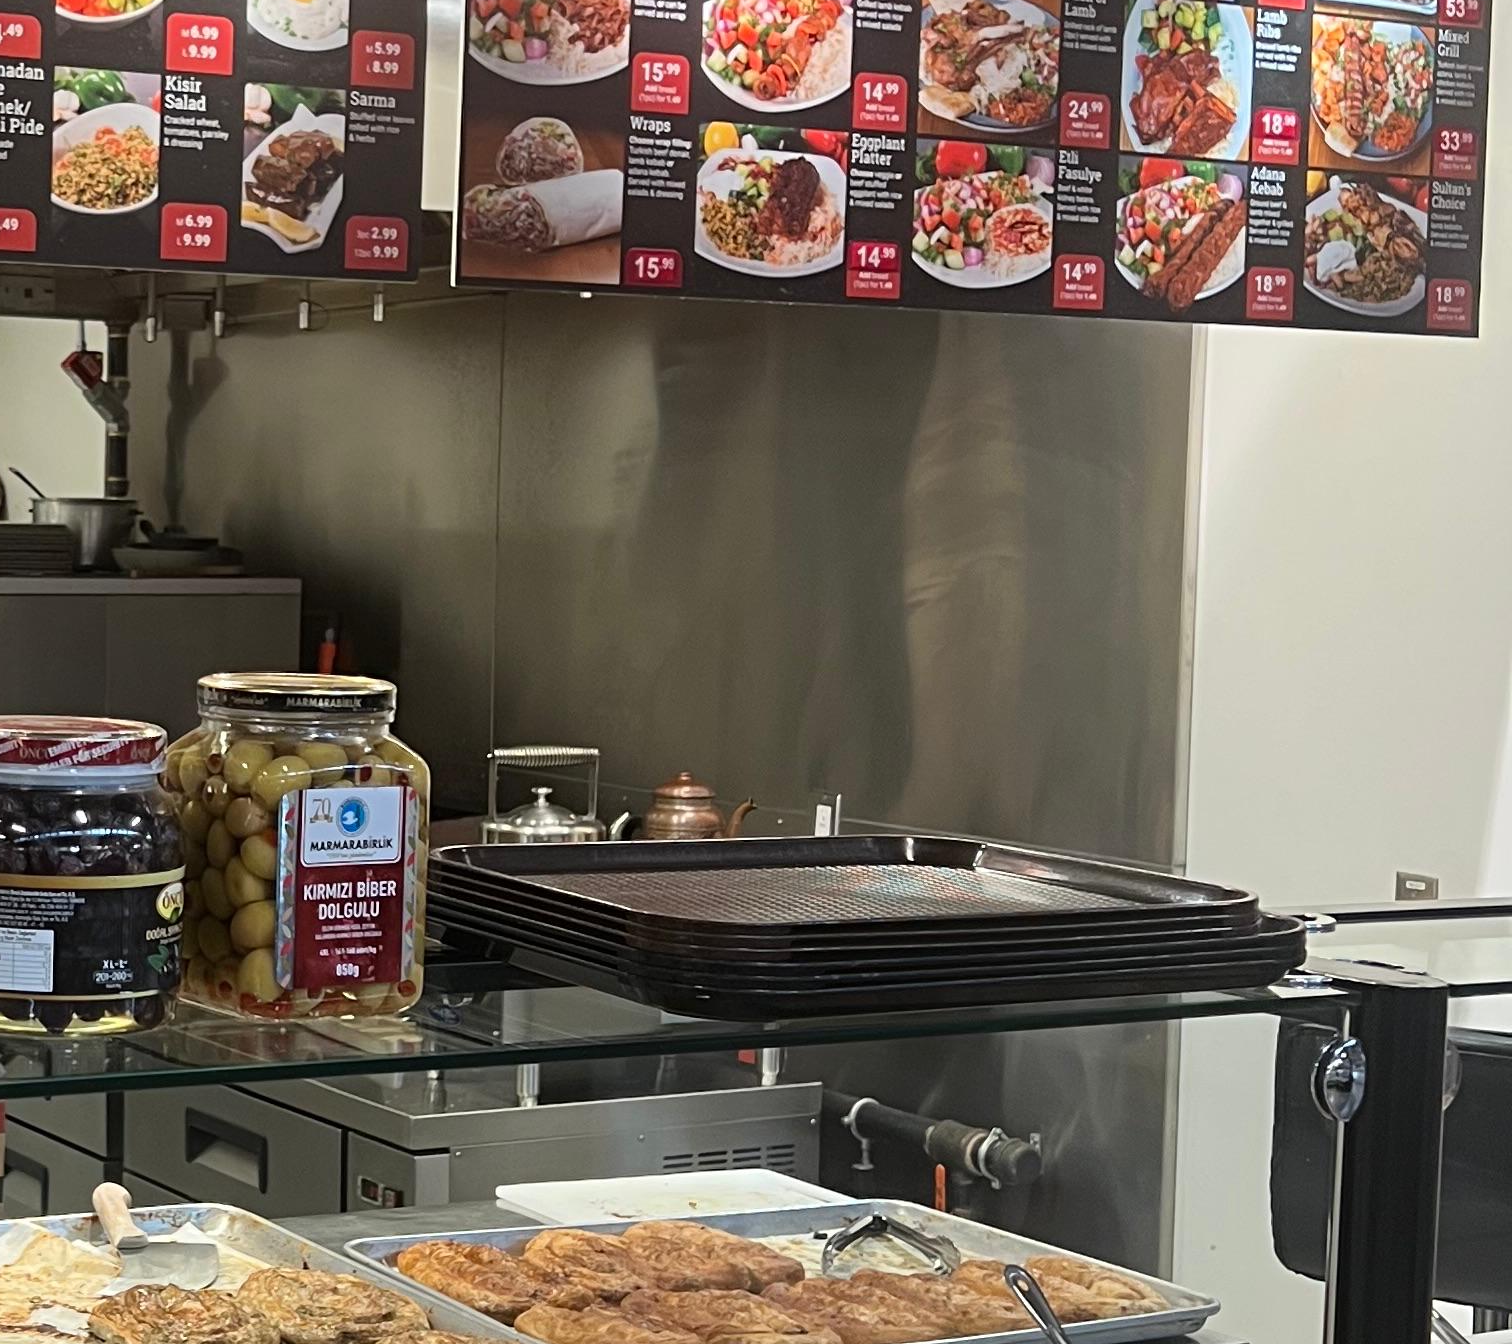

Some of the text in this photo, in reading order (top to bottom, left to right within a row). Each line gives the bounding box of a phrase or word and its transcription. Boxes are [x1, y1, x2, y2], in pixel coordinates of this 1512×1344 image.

[1065, 2, 1096, 18] Lamb
[1257, 9, 1288, 25] Lamb
[190, 25, 219, 40] 6.99
[1257, 24, 1281, 39] Ribs
[1439, 29, 1469, 44] Mixed
[188, 44, 217, 59] 9.99
[374, 41, 401, 56] 5.99
[1438, 44, 1460, 57] Grill
[372, 60, 399, 74] 8.99
[641, 62, 681, 82] 15.99
[165, 75, 202, 93] Kisir
[863, 81, 899, 101] 14.99
[164, 93, 206, 112] Salad
[350, 91, 396, 108] Sarma
[1068, 100, 1103, 119] 24.99
[9, 118, 44, 135] Pide
[630, 116, 671, 135] Wraps
[852, 133, 905, 151] Eggplant
[851, 150, 892, 166] Platter
[1058, 166, 1102, 184] Fasulye
[1251, 166, 1285, 182] Adana
[1251, 181, 1283, 196] Kebab
[1432, 181, 1472, 196] Sultan's
[1432, 195, 1465, 210] Choice
[185, 215, 213, 228] 6.99
[183, 233, 211, 247] 9.99
[371, 227, 398, 240] 2.99
[372, 245, 399, 258] 9.99
[1063, 263, 1096, 281] 14.99
[310, 836, 393, 851] MARMARABİRLİK
[304, 878, 396, 900] KIRMIZI BİBER
[319, 901, 379, 920] DOLGULU
